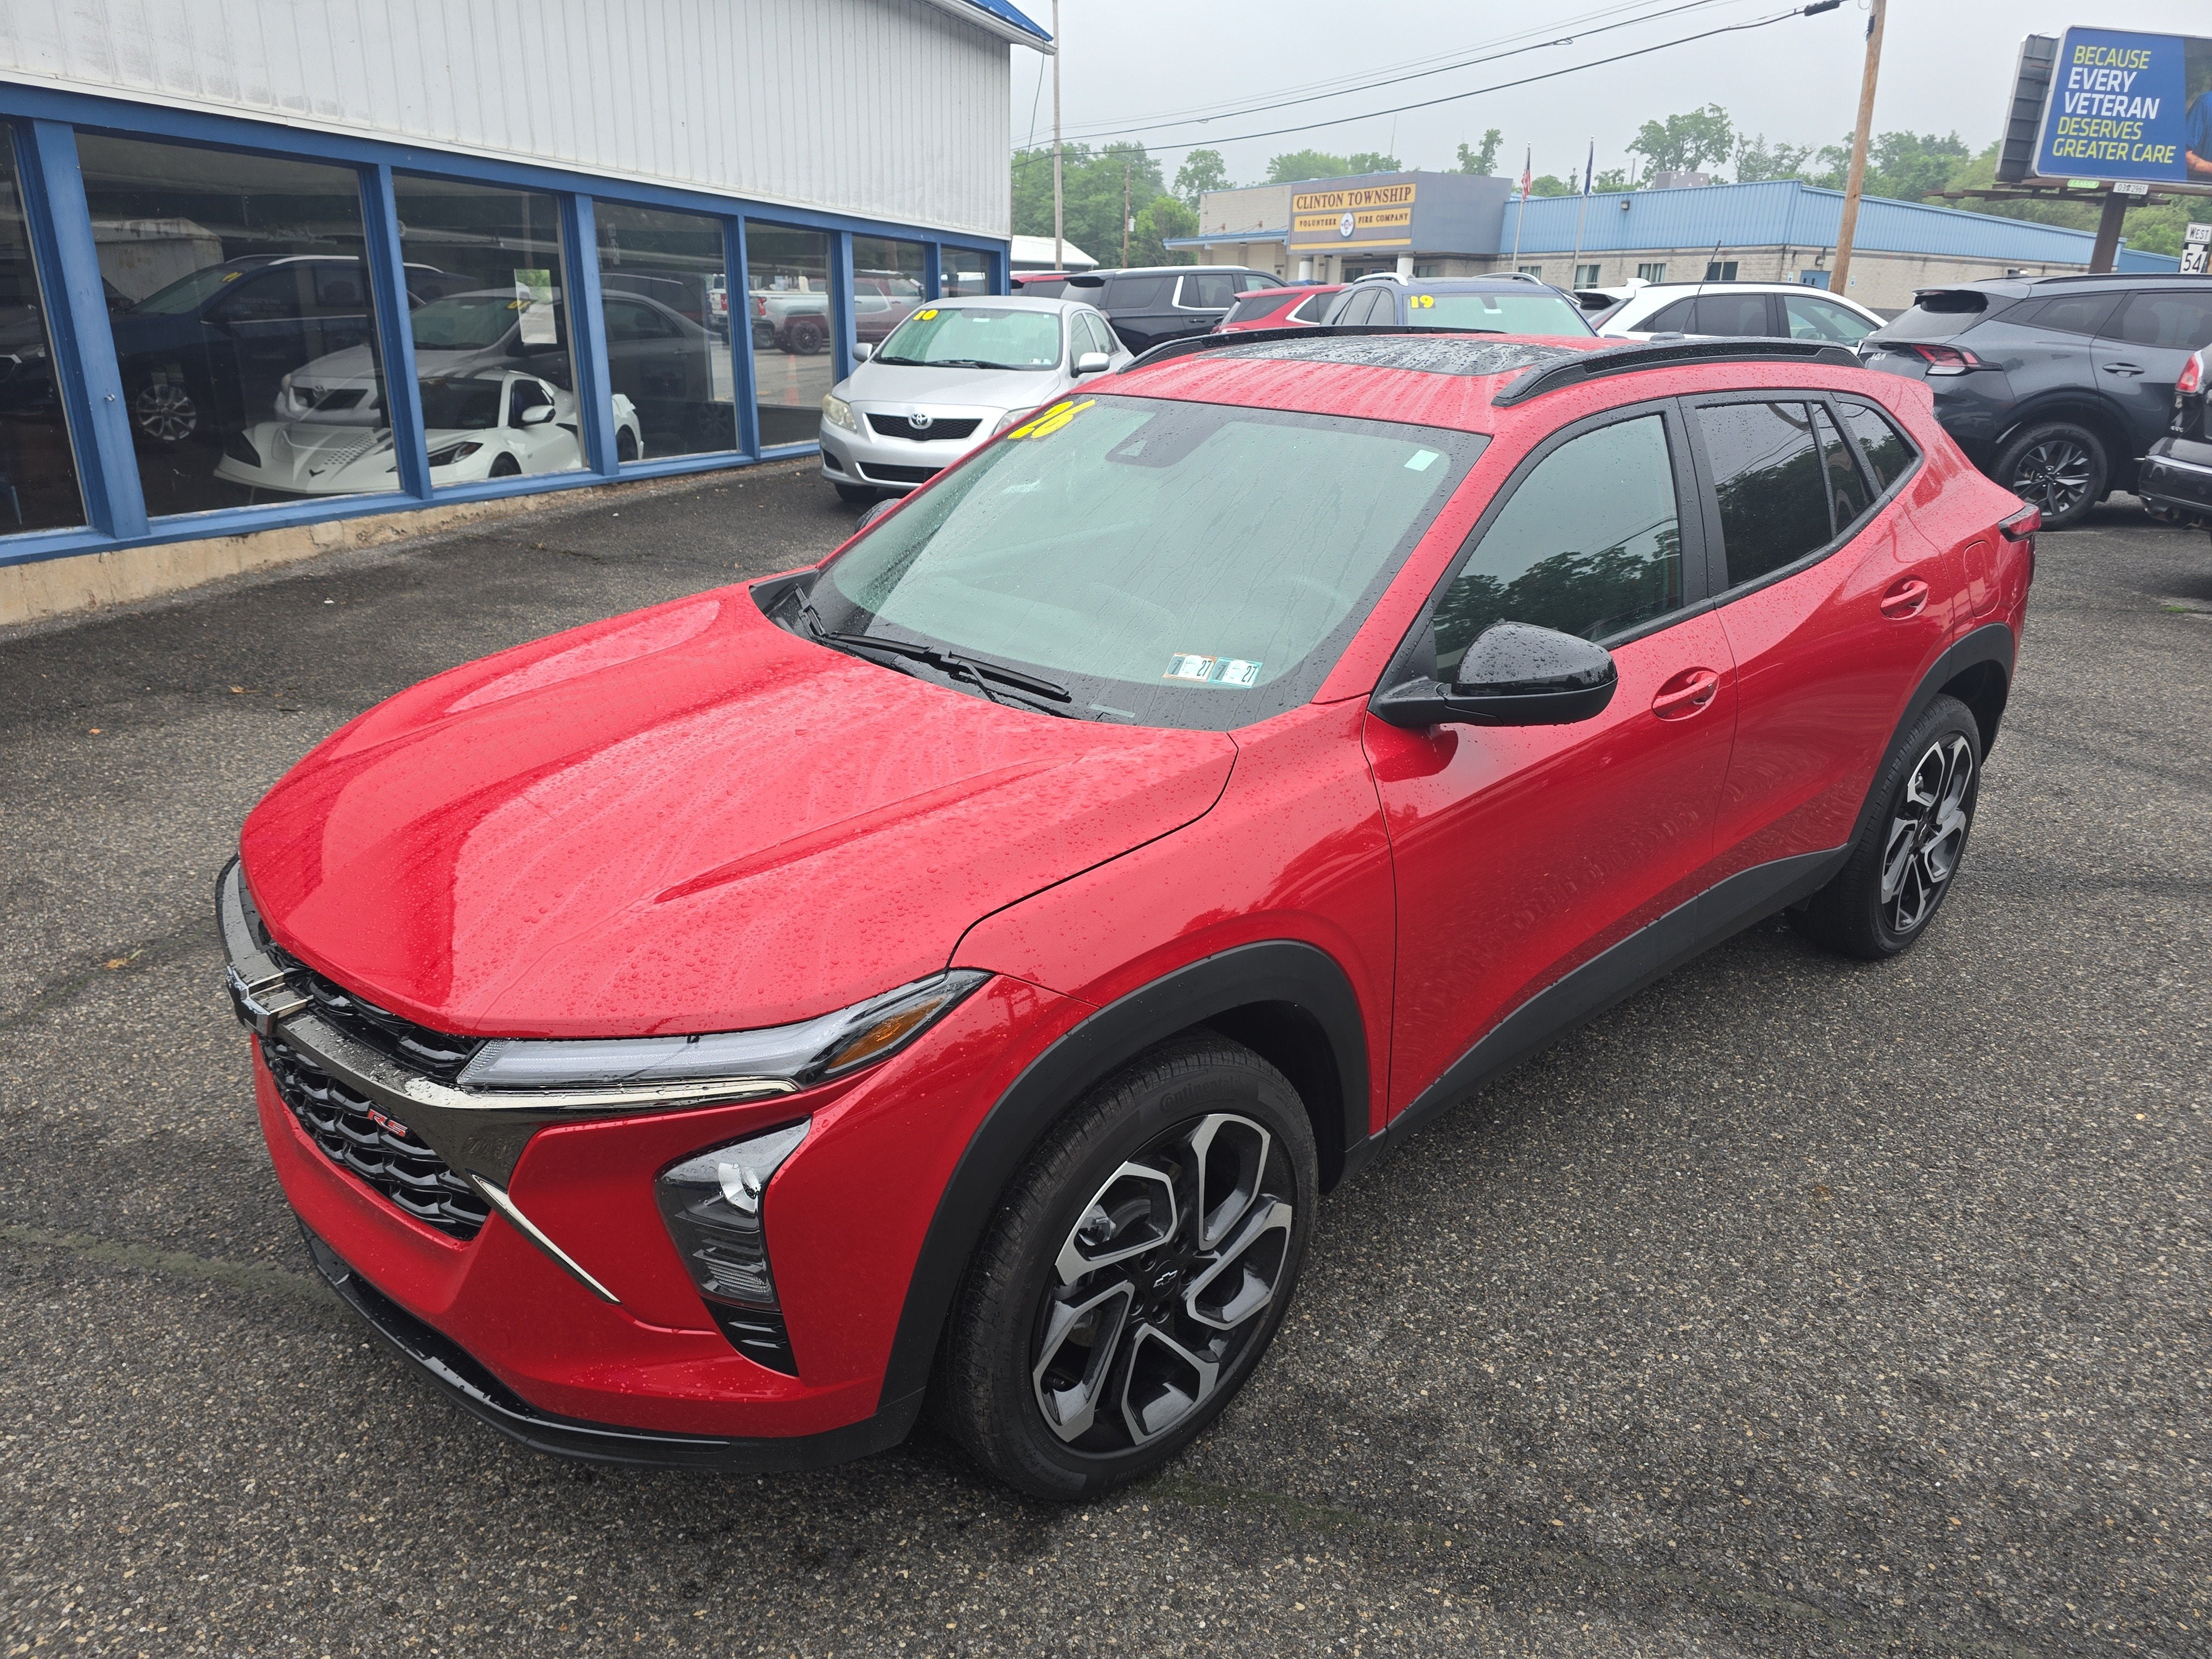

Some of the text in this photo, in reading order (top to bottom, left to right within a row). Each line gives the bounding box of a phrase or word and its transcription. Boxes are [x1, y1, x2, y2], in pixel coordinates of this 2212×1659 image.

[2073, 45, 2151, 69] BECAUSE
[2068, 67, 2137, 93] EVERY
[2065, 92, 2160, 119] VETERAN
[2057, 116, 2144, 140] DESERVES
[2052, 138, 2176, 164] GREATER CARE
[1296, 187, 1411, 209] CLINTON TOWNSHIP
[1299, 213, 1409, 227] VOLUNTEER FIRE COMPANY
[2190, 227, 2209, 240] WEST
[2183, 252, 2202, 272] 54
[1410, 295, 1434, 308] 19
[913, 309, 938, 320] 10
[1007, 398, 1096, 439] 26
[1196, 660, 1212, 677] 27
[1241, 665, 1257, 683] 27
[367, 1108, 408, 1137] RS
